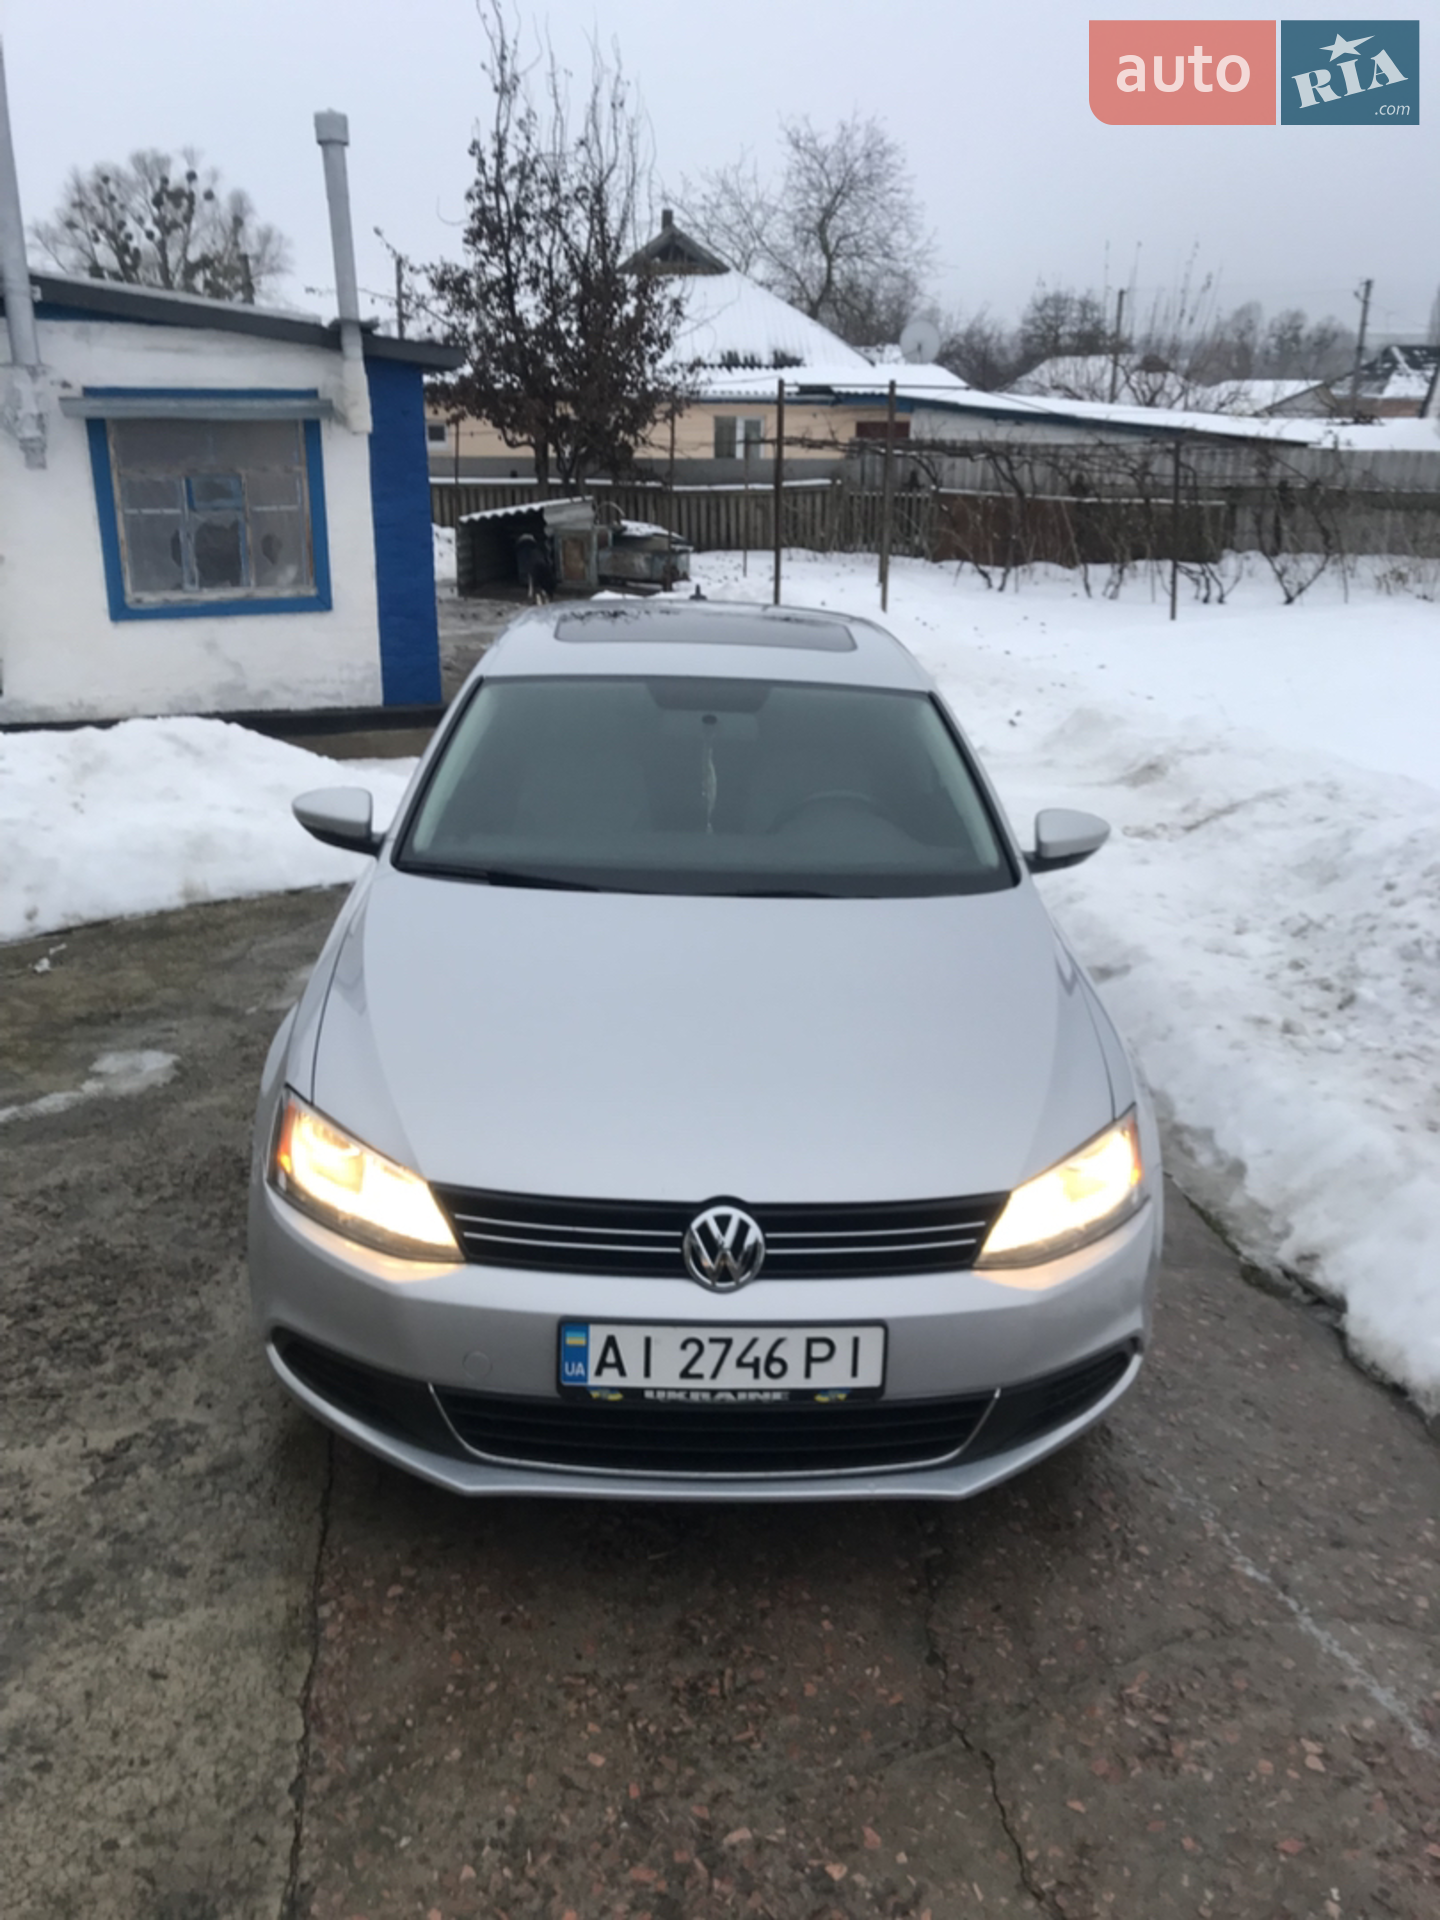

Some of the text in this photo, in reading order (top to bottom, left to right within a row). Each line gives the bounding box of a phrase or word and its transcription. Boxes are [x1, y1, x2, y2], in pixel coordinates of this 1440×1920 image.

[565, 1362, 585, 1376] UA
[594, 1335, 860, 1380] AI 2746 PI
